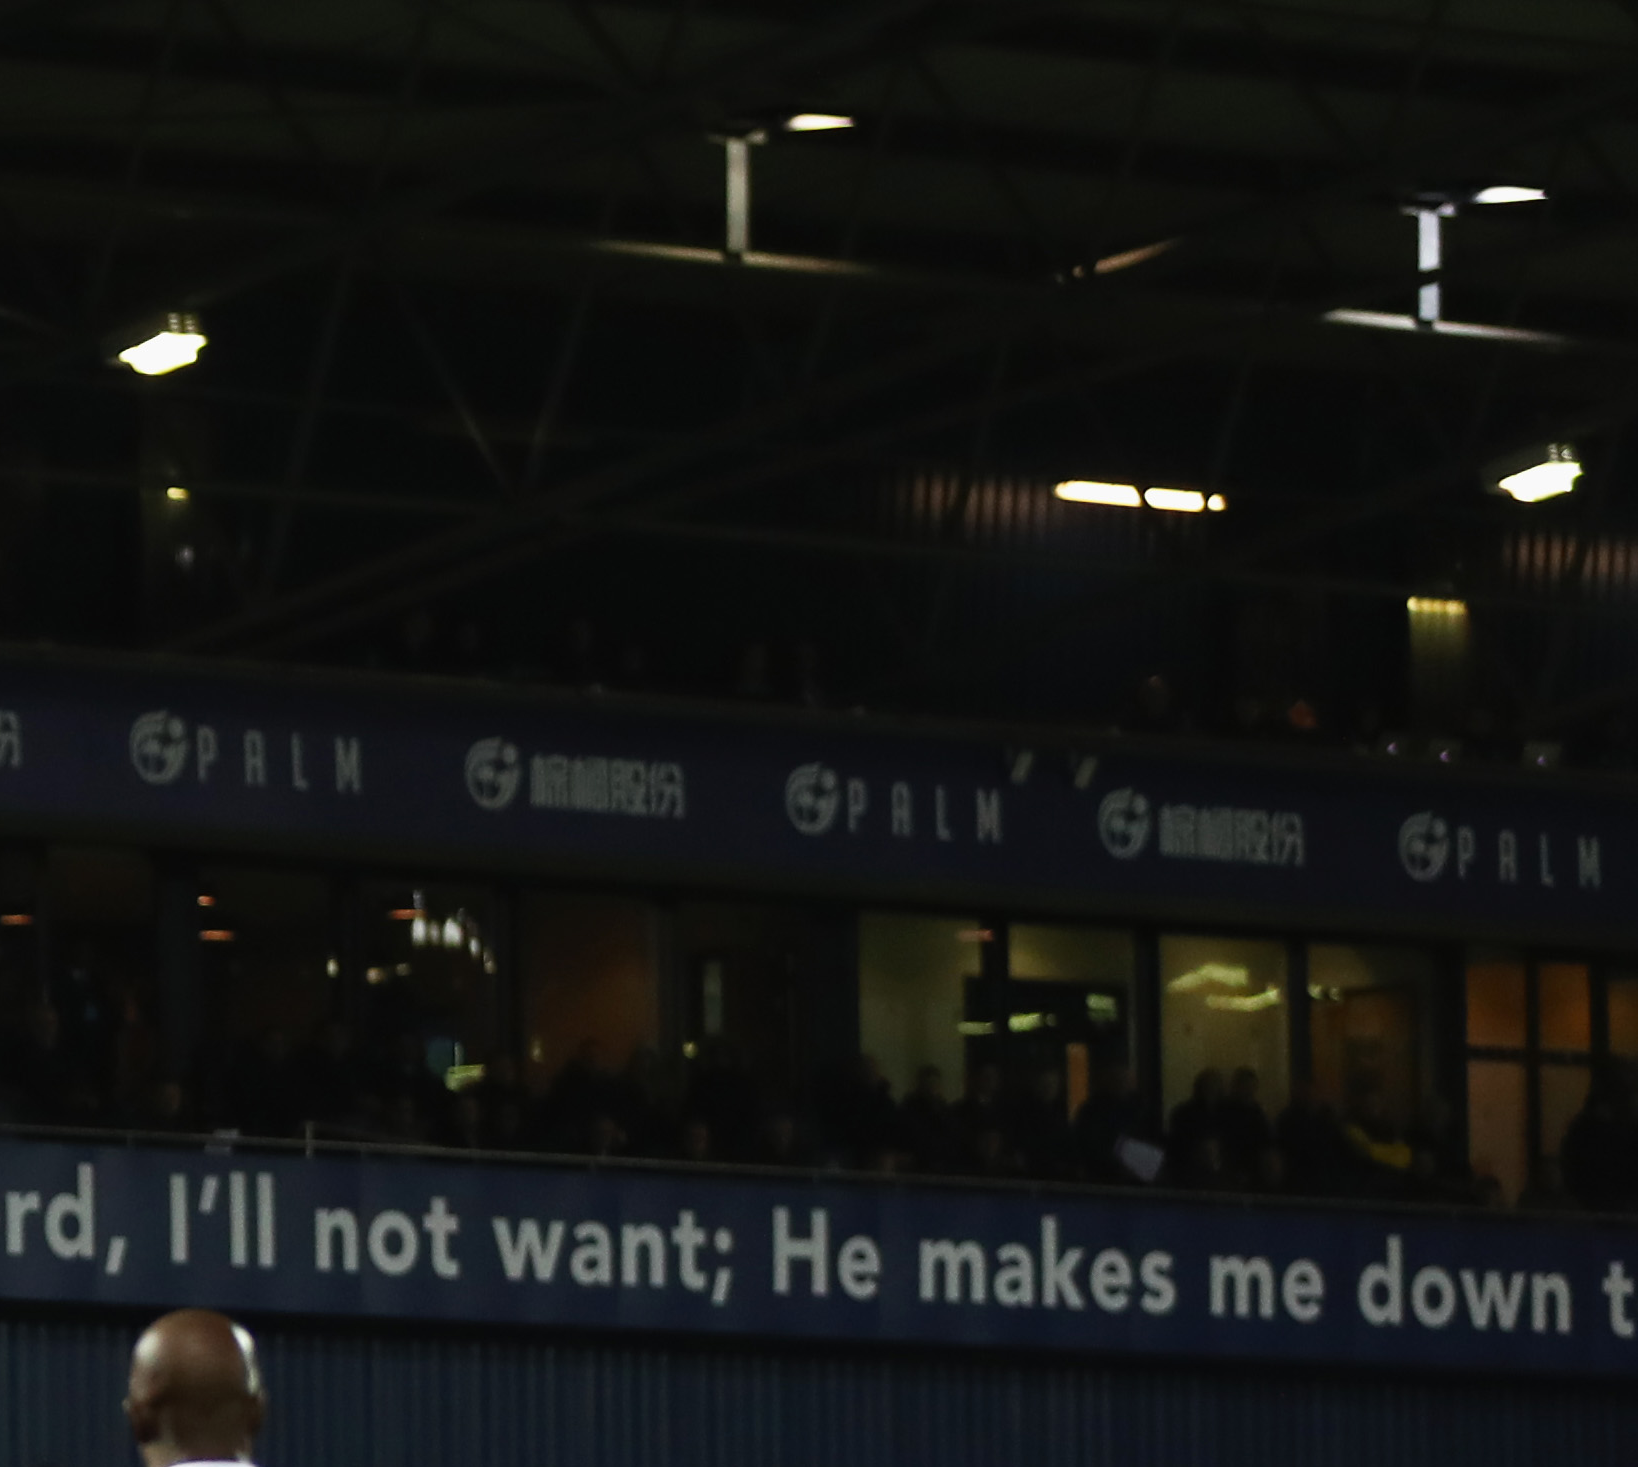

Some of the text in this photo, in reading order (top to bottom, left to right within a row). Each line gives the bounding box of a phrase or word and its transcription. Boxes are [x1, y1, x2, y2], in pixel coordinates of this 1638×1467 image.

[197, 725, 361, 792] PALM
[847, 778, 1000, 841] PALM
[1457, 826, 1601, 887] PALM
[171, 1173, 274, 1267] I'll
[315, 1198, 459, 1277] not
[493, 1212, 732, 1304] want;
[774, 1208, 880, 1298] He
[919, 1217, 1175, 1313] makes
[1210, 1256, 1324, 1321] me
[1358, 1236, 1571, 1333] down
